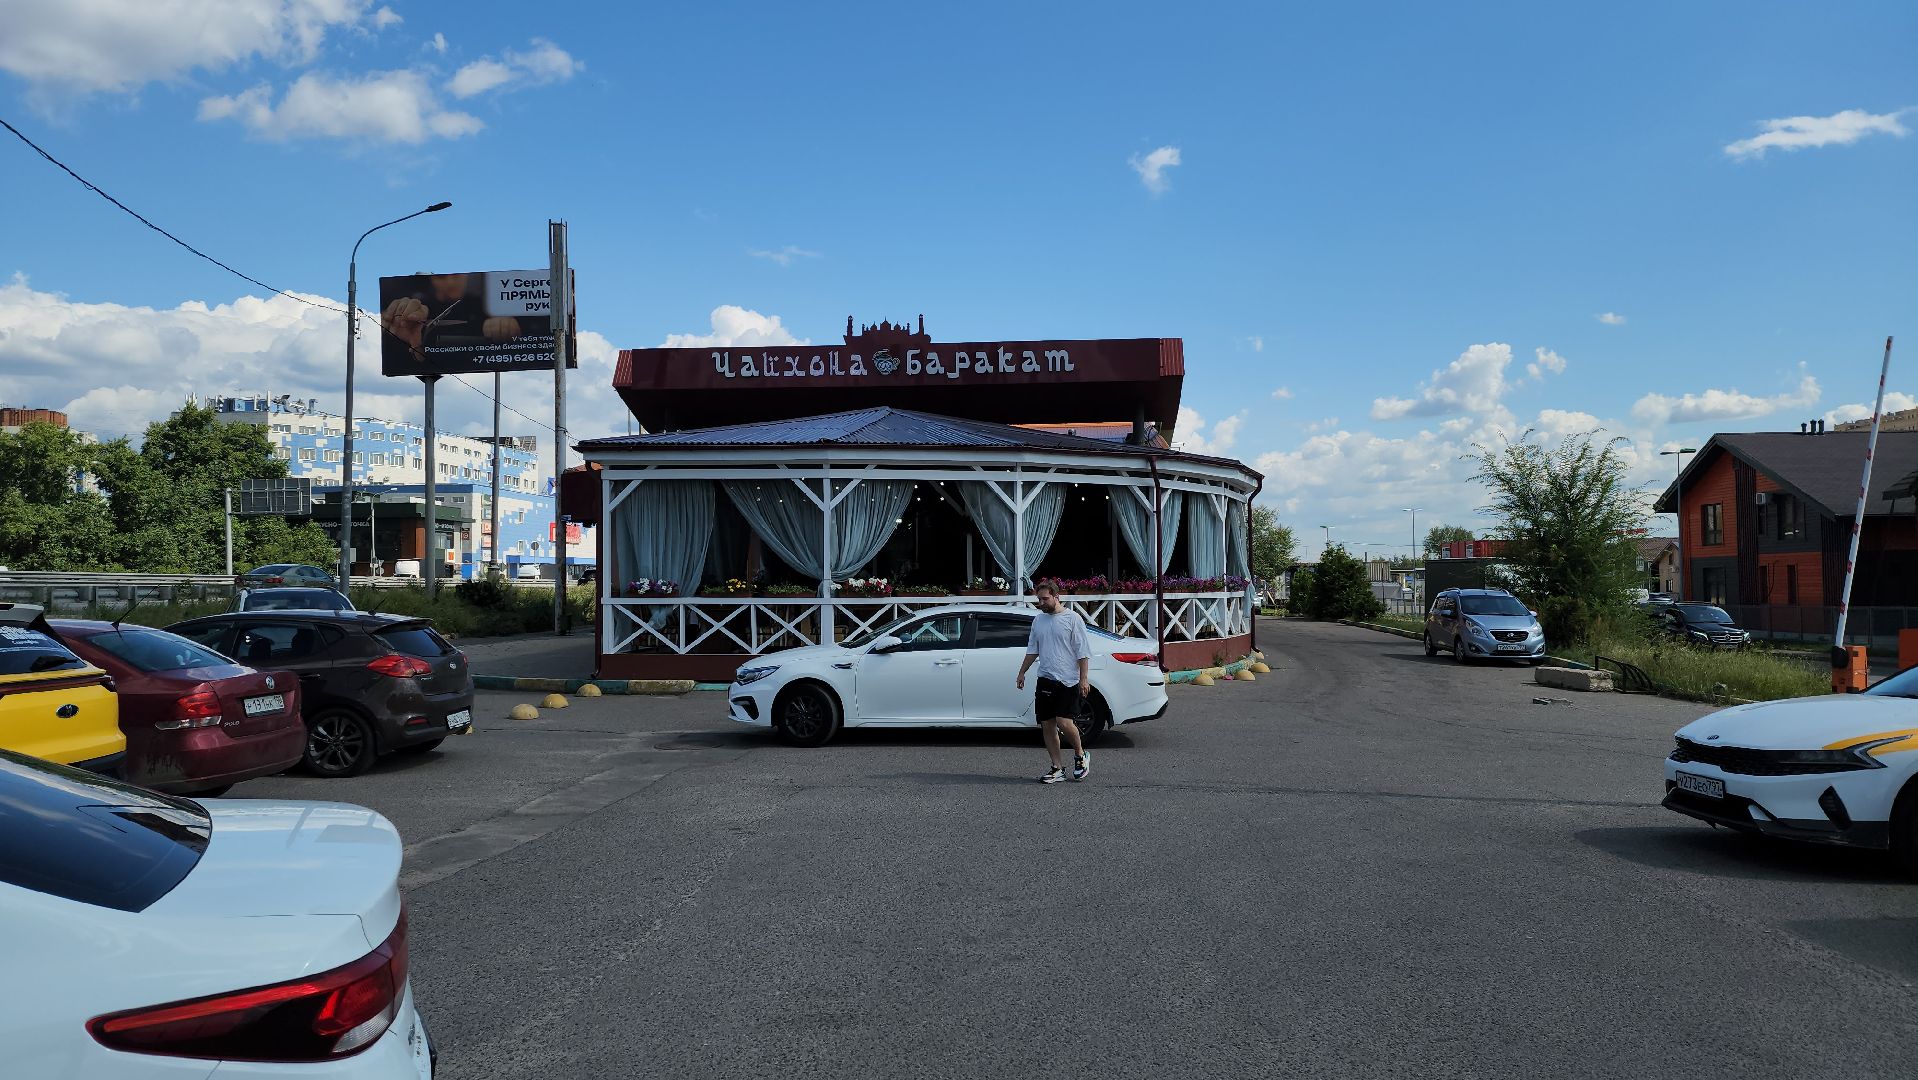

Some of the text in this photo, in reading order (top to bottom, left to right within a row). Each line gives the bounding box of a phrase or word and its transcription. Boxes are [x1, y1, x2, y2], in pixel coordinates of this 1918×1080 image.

[500, 279, 551, 288] У Серге
[500, 290, 551, 300] ПРЯМЫ
[525, 301, 550, 311] рук
